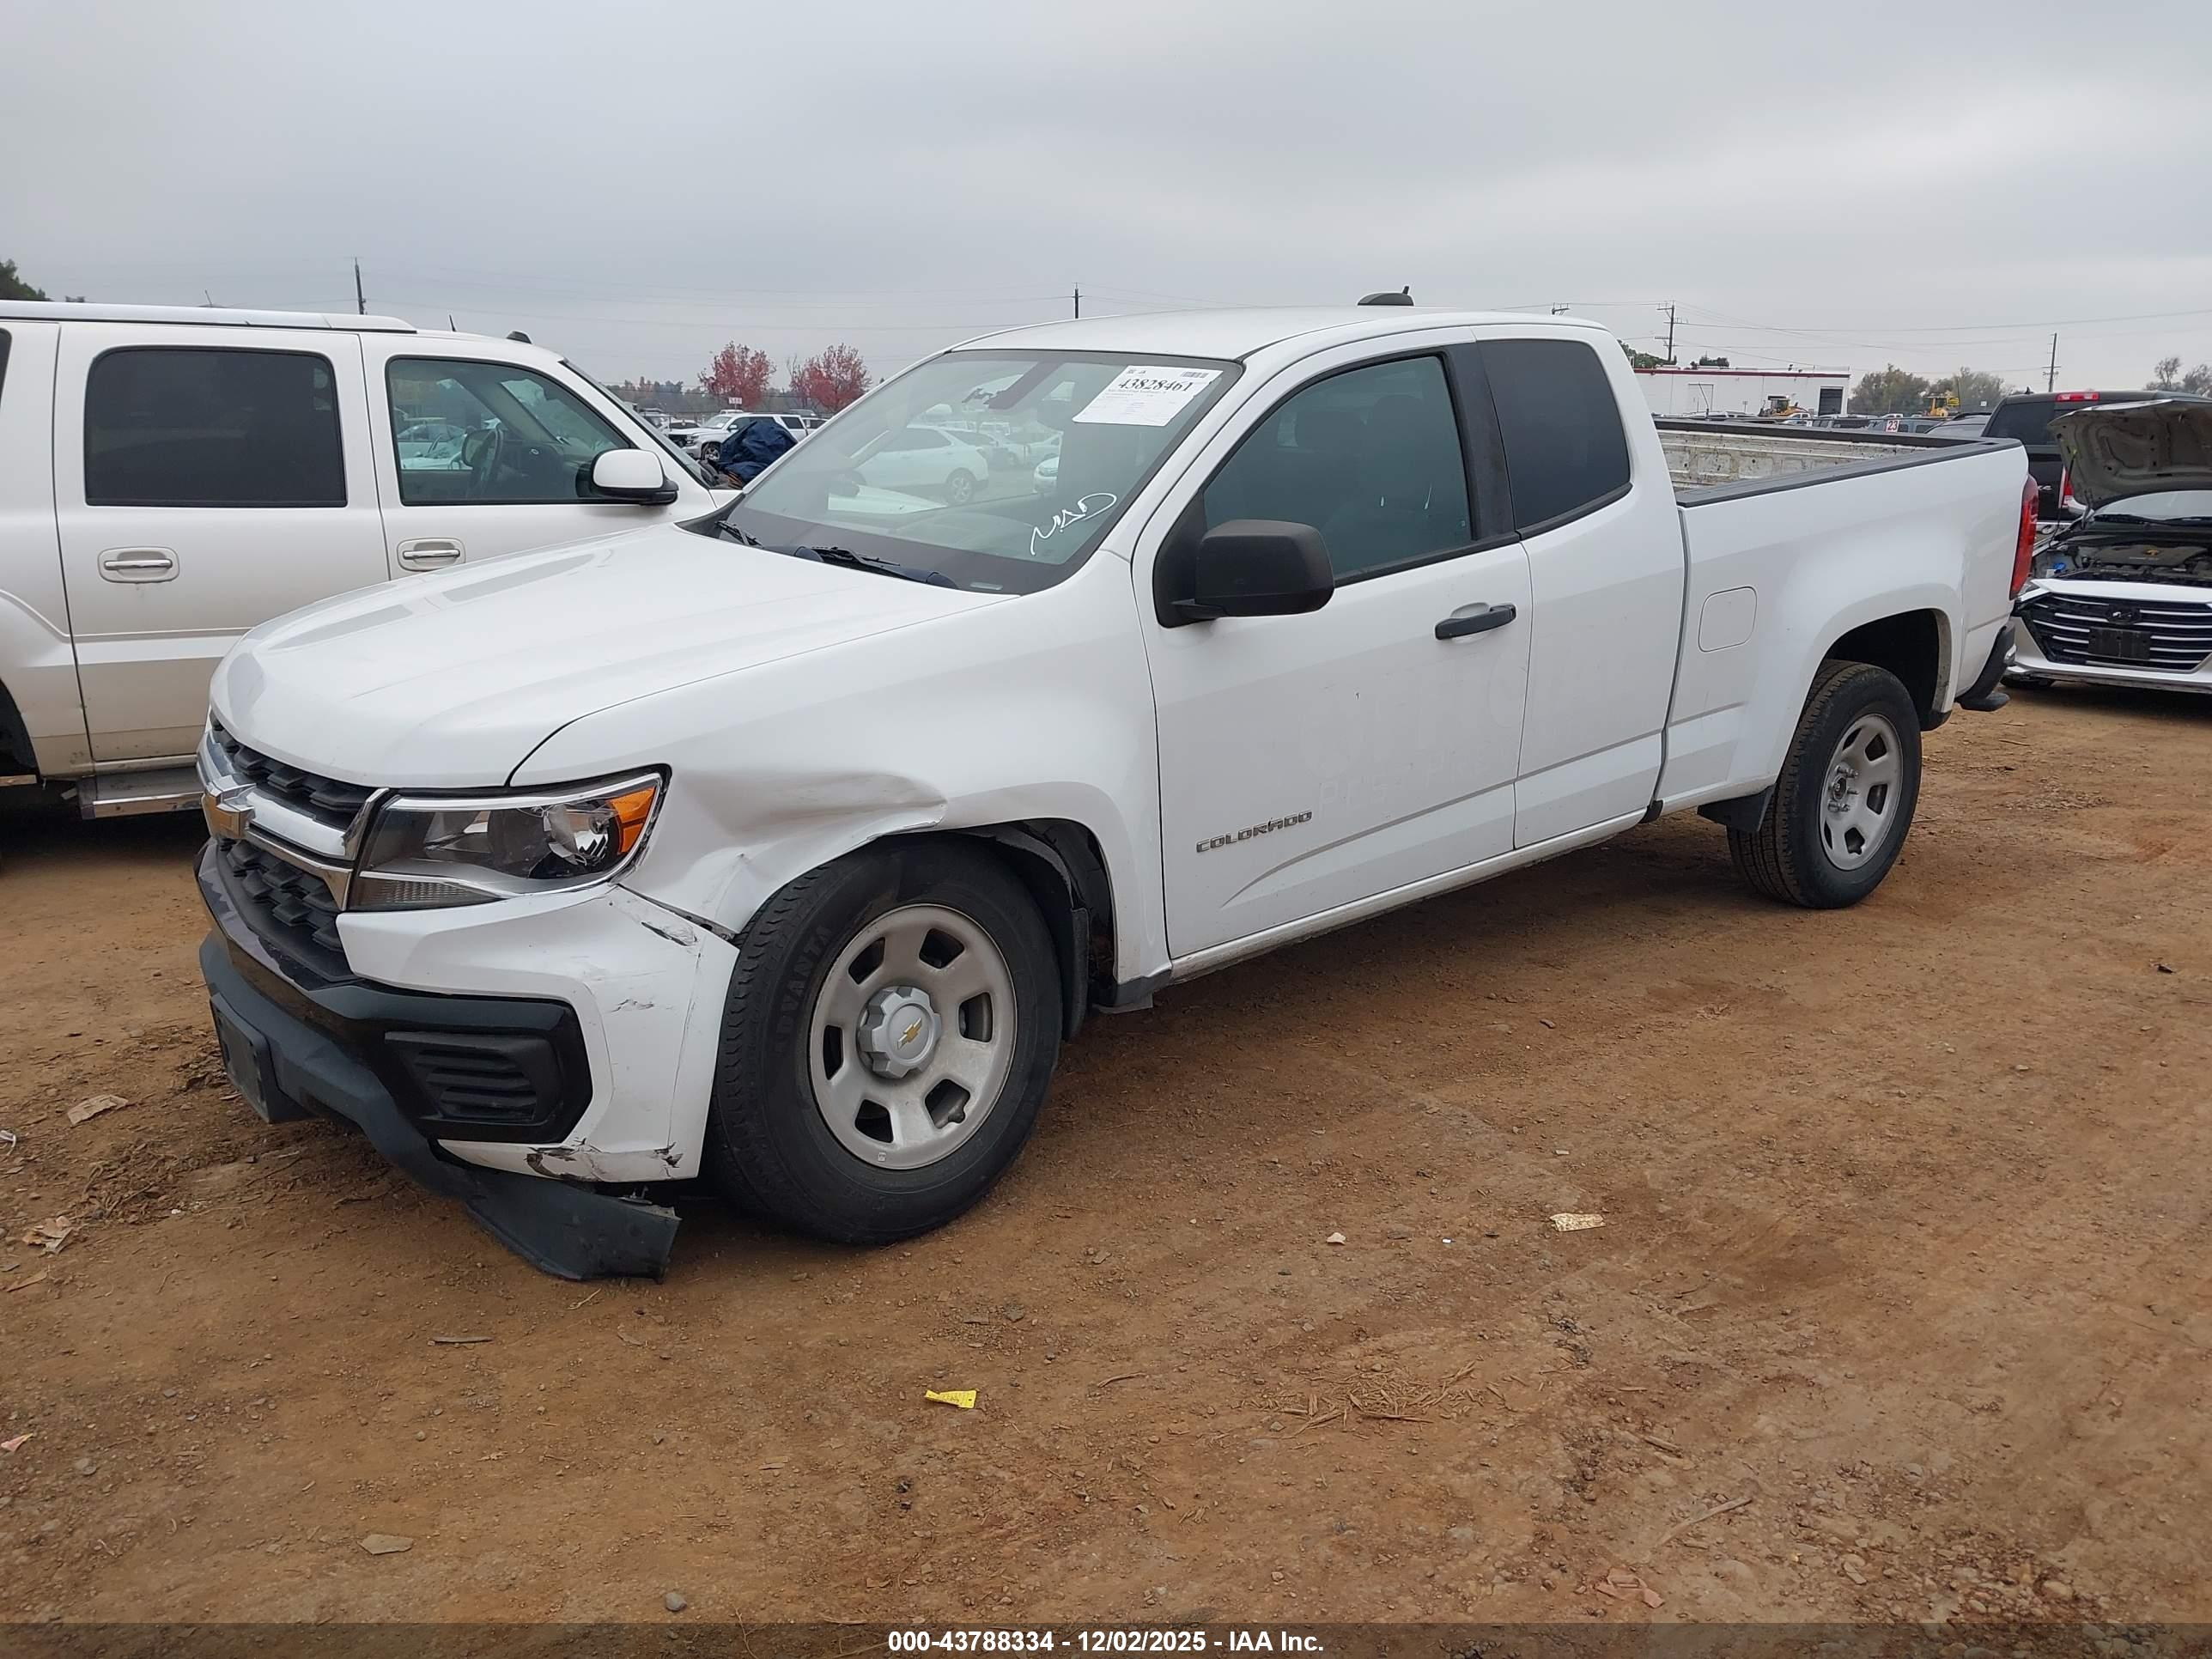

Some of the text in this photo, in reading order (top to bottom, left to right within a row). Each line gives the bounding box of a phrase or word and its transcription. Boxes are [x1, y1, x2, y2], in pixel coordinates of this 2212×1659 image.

[1118, 378, 1194, 392] 43828461
[1887, 420, 1898, 431] 23
[1196, 810, 1313, 853] COLORADO
